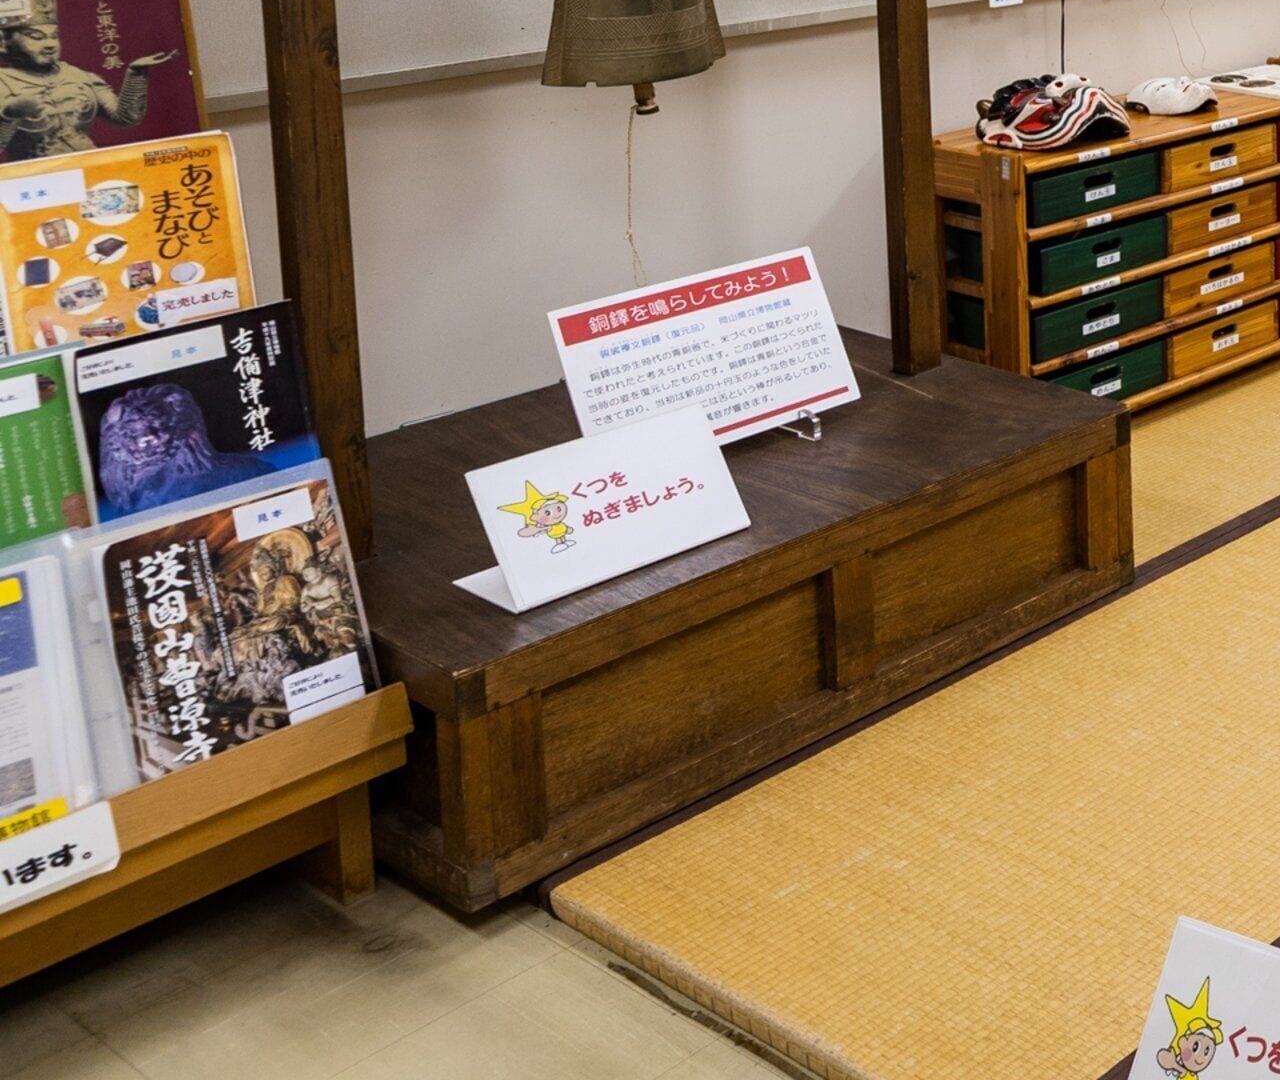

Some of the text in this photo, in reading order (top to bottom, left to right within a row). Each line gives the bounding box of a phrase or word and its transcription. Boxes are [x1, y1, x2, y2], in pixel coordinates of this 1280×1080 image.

[144, 148, 211, 167] 歴史の中の
[152, 190, 190, 260] まなび
[180, 163, 220, 245] あそびと
[162, 288, 234, 311] 完売しました
[588, 266, 790, 334] 銅鐸を鳴らしてみよう！
[229, 328, 276, 451] 吉備津神社
[571, 471, 629, 499] くつを
[582, 477, 704, 527] ぬぎましょう。
[257, 509, 283, 523] 見本
